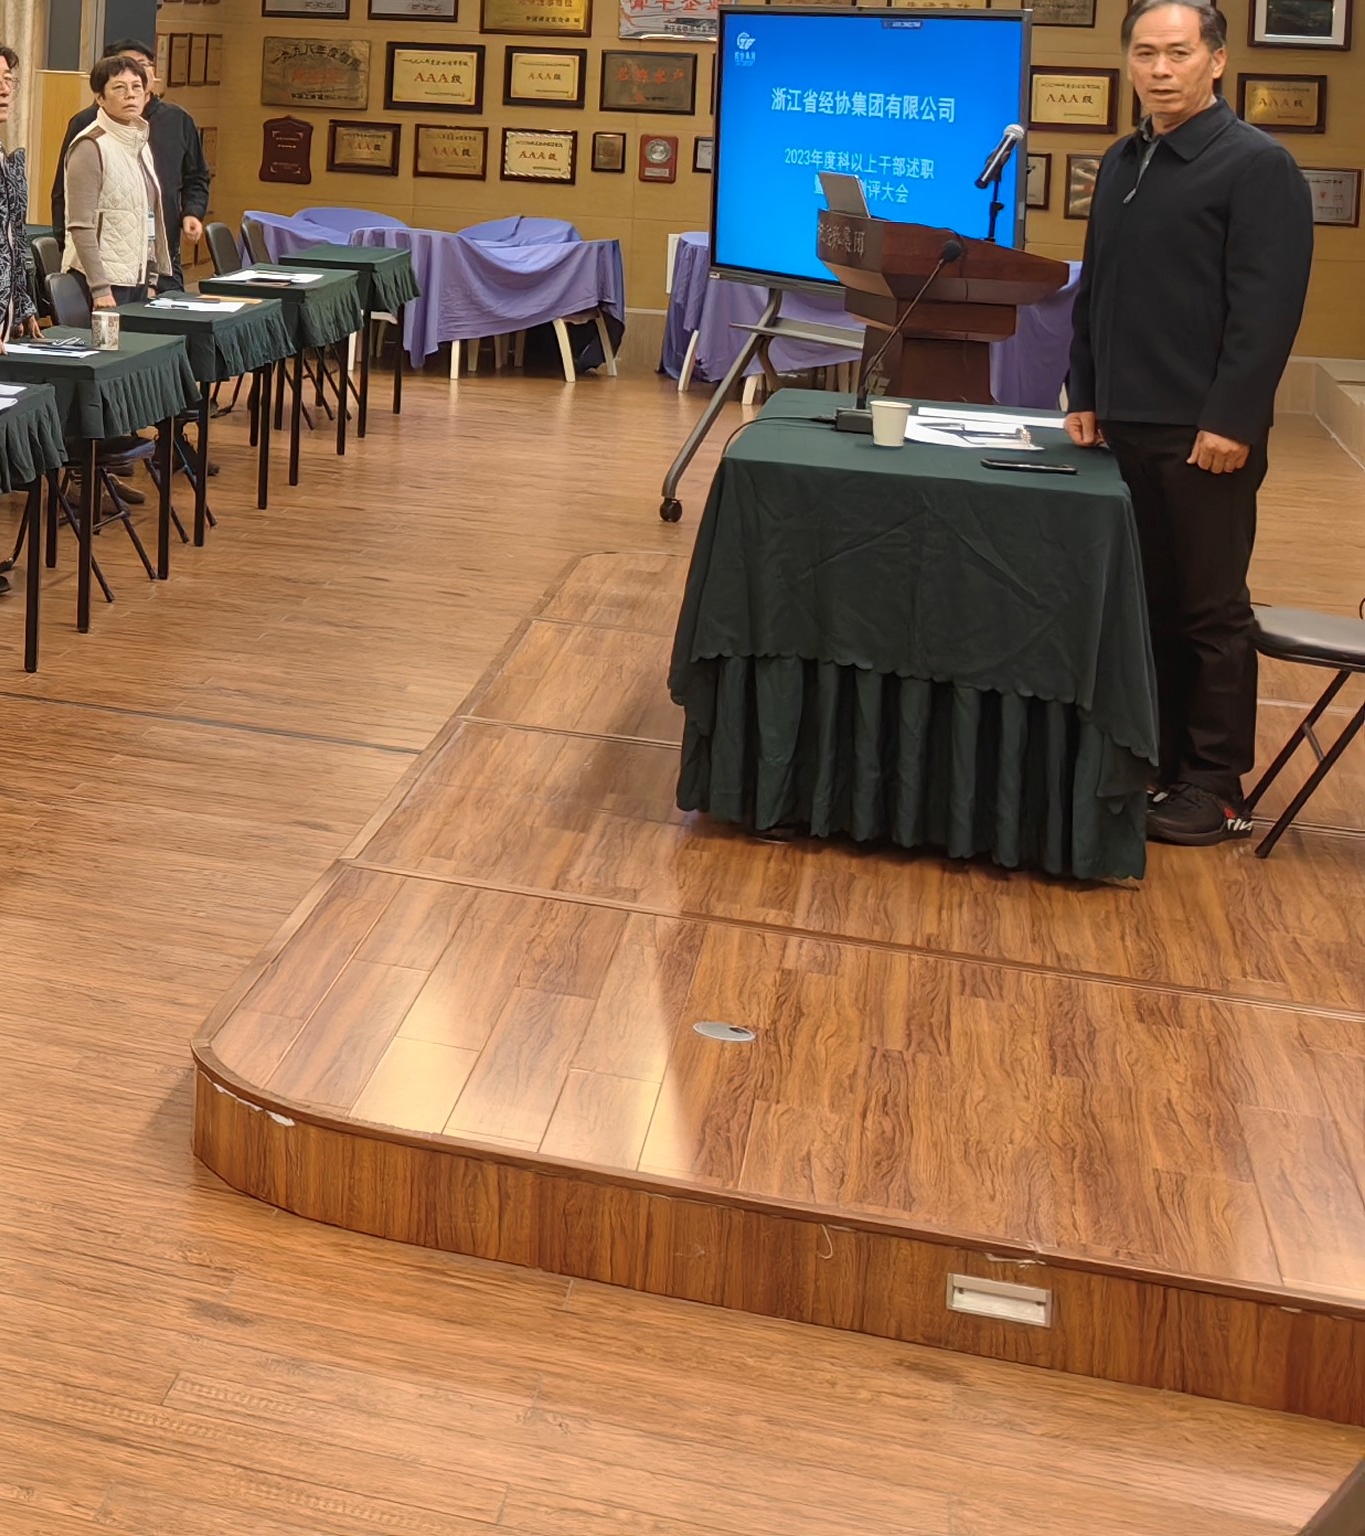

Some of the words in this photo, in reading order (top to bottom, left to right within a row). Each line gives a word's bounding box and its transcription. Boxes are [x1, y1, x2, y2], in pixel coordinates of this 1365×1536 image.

[414, 72, 463, 85] AAA级
[771, 87, 956, 123] 浙江省经协集团有限公司
[1046, 93, 1093, 105] AAA级
[519, 150, 557, 161] AAA级
[785, 148, 935, 180] 2023年度科以上干部述职
